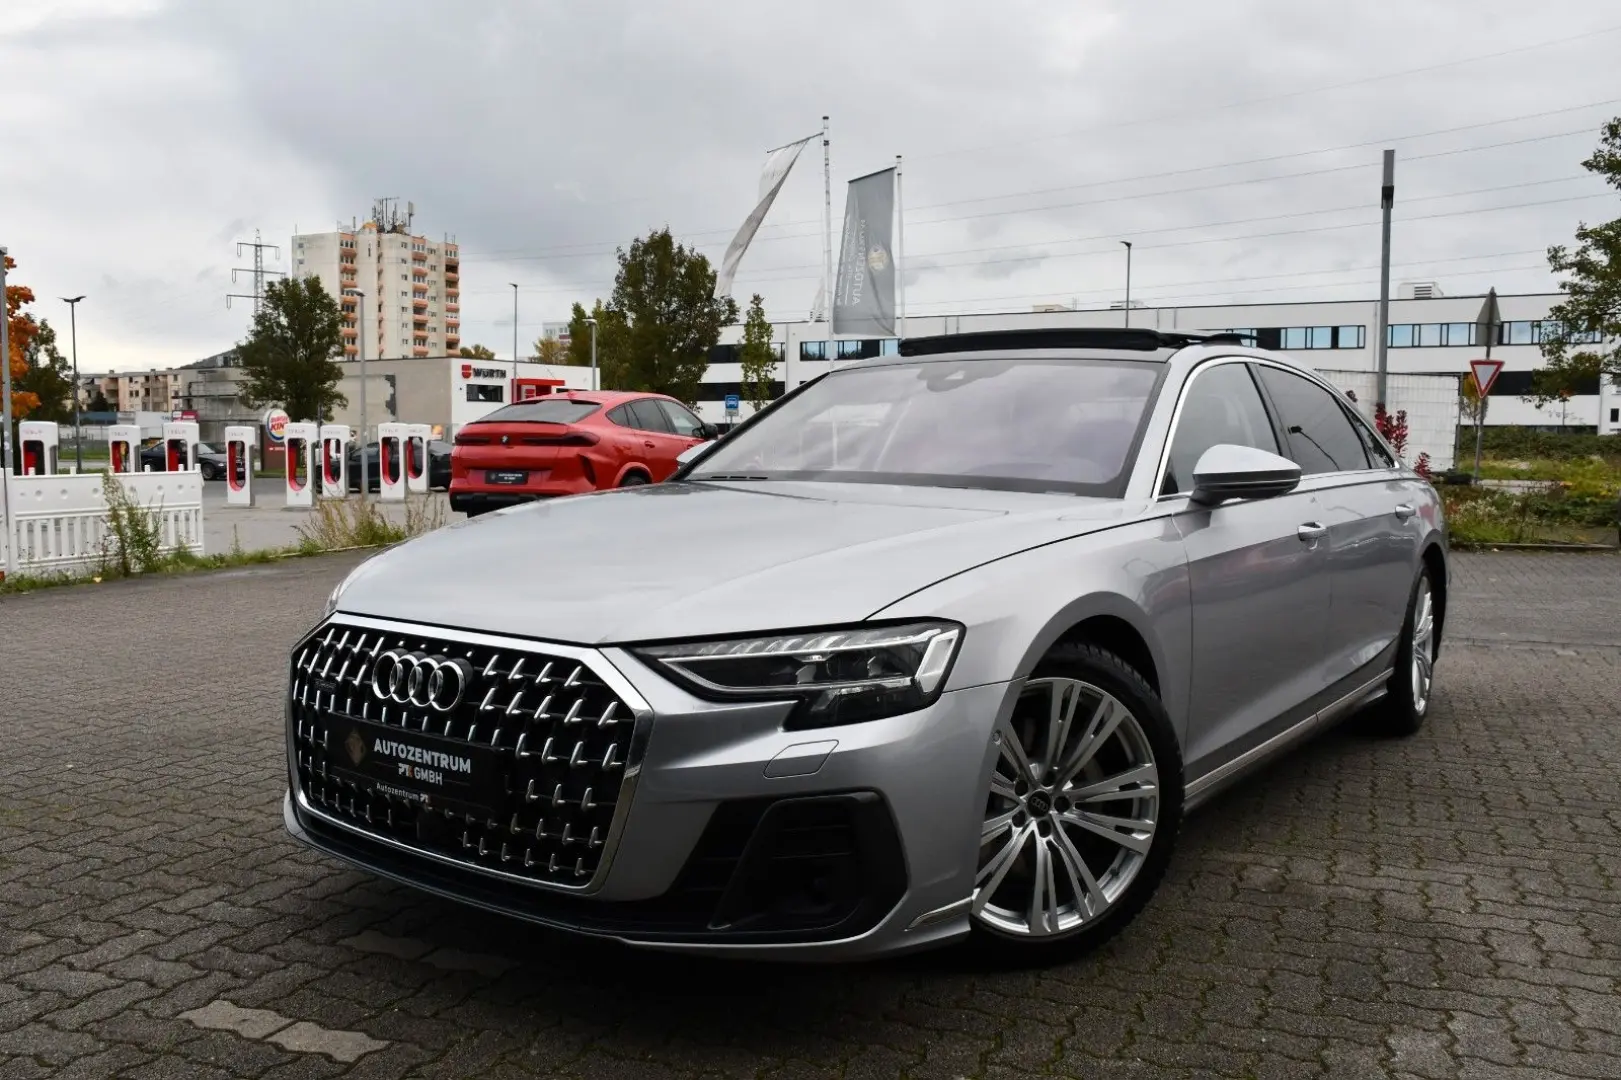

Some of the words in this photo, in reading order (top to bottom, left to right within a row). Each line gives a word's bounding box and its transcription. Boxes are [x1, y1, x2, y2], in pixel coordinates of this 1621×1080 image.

[374, 738, 471, 774] AUTOZENTRUM
[414, 768, 443, 786] GMBH
[376, 782, 419, 801] Autozentrum
